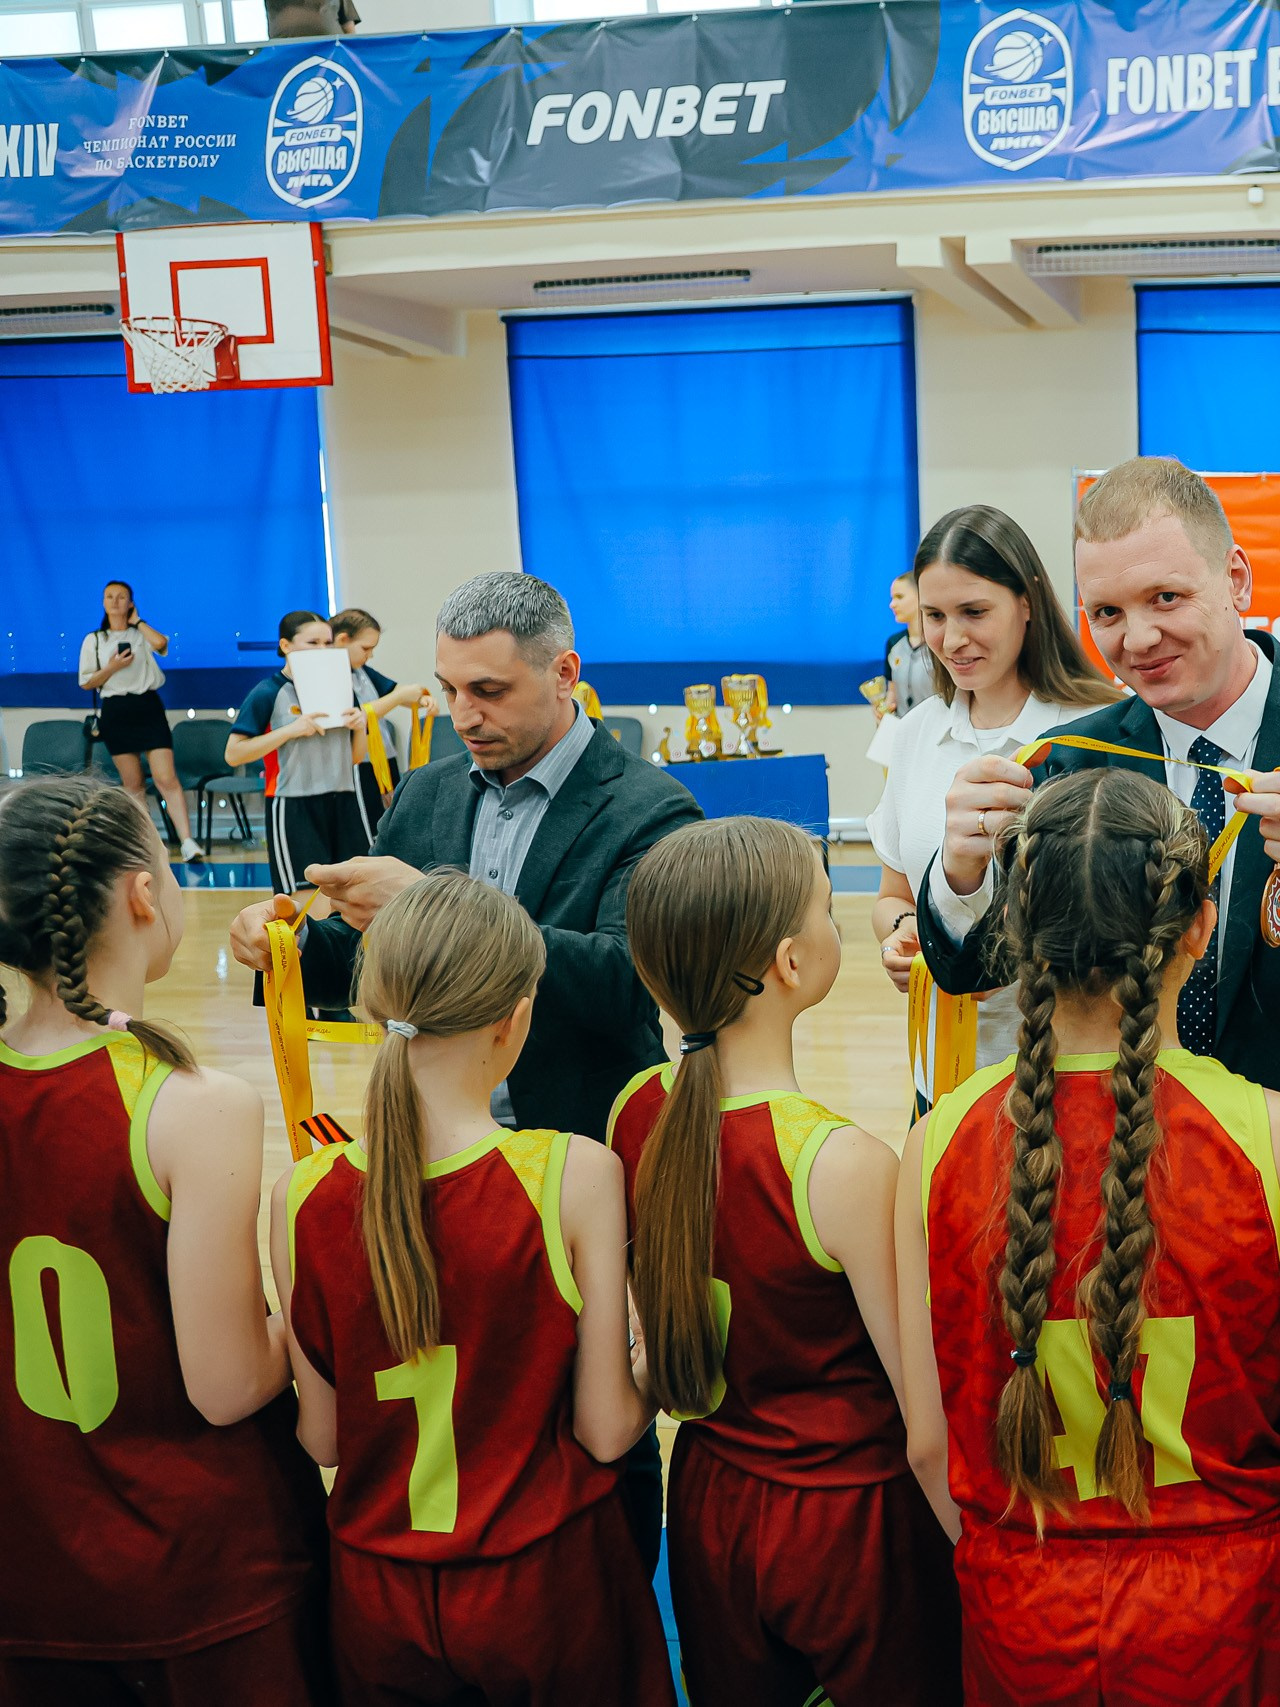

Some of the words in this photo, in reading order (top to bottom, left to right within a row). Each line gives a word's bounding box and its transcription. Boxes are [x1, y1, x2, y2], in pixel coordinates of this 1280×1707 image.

[1106, 47, 1258, 116] FONBET
[989, 86, 1046, 100] FONBET
[128, 114, 189, 130] FONBET
[526, 79, 787, 146] FONBET
[978, 104, 1059, 135] ВЫСШАЯ
[83, 135, 169, 155] ЧЕМПИОНАТ
[174, 133, 237, 150] РОССИИ
[288, 127, 337, 142] FONBET
[989, 134, 1044, 151] ЛИГА
[0, 122, 59, 178] XIV
[276, 146, 348, 176] ВЫСШАЯ
[95, 158, 112, 173] ПО
[114, 154, 221, 170] БАСКЕТБОЛУ
[285, 174, 334, 190] ЛИГА
[9, 1235, 119, 1433] 0
